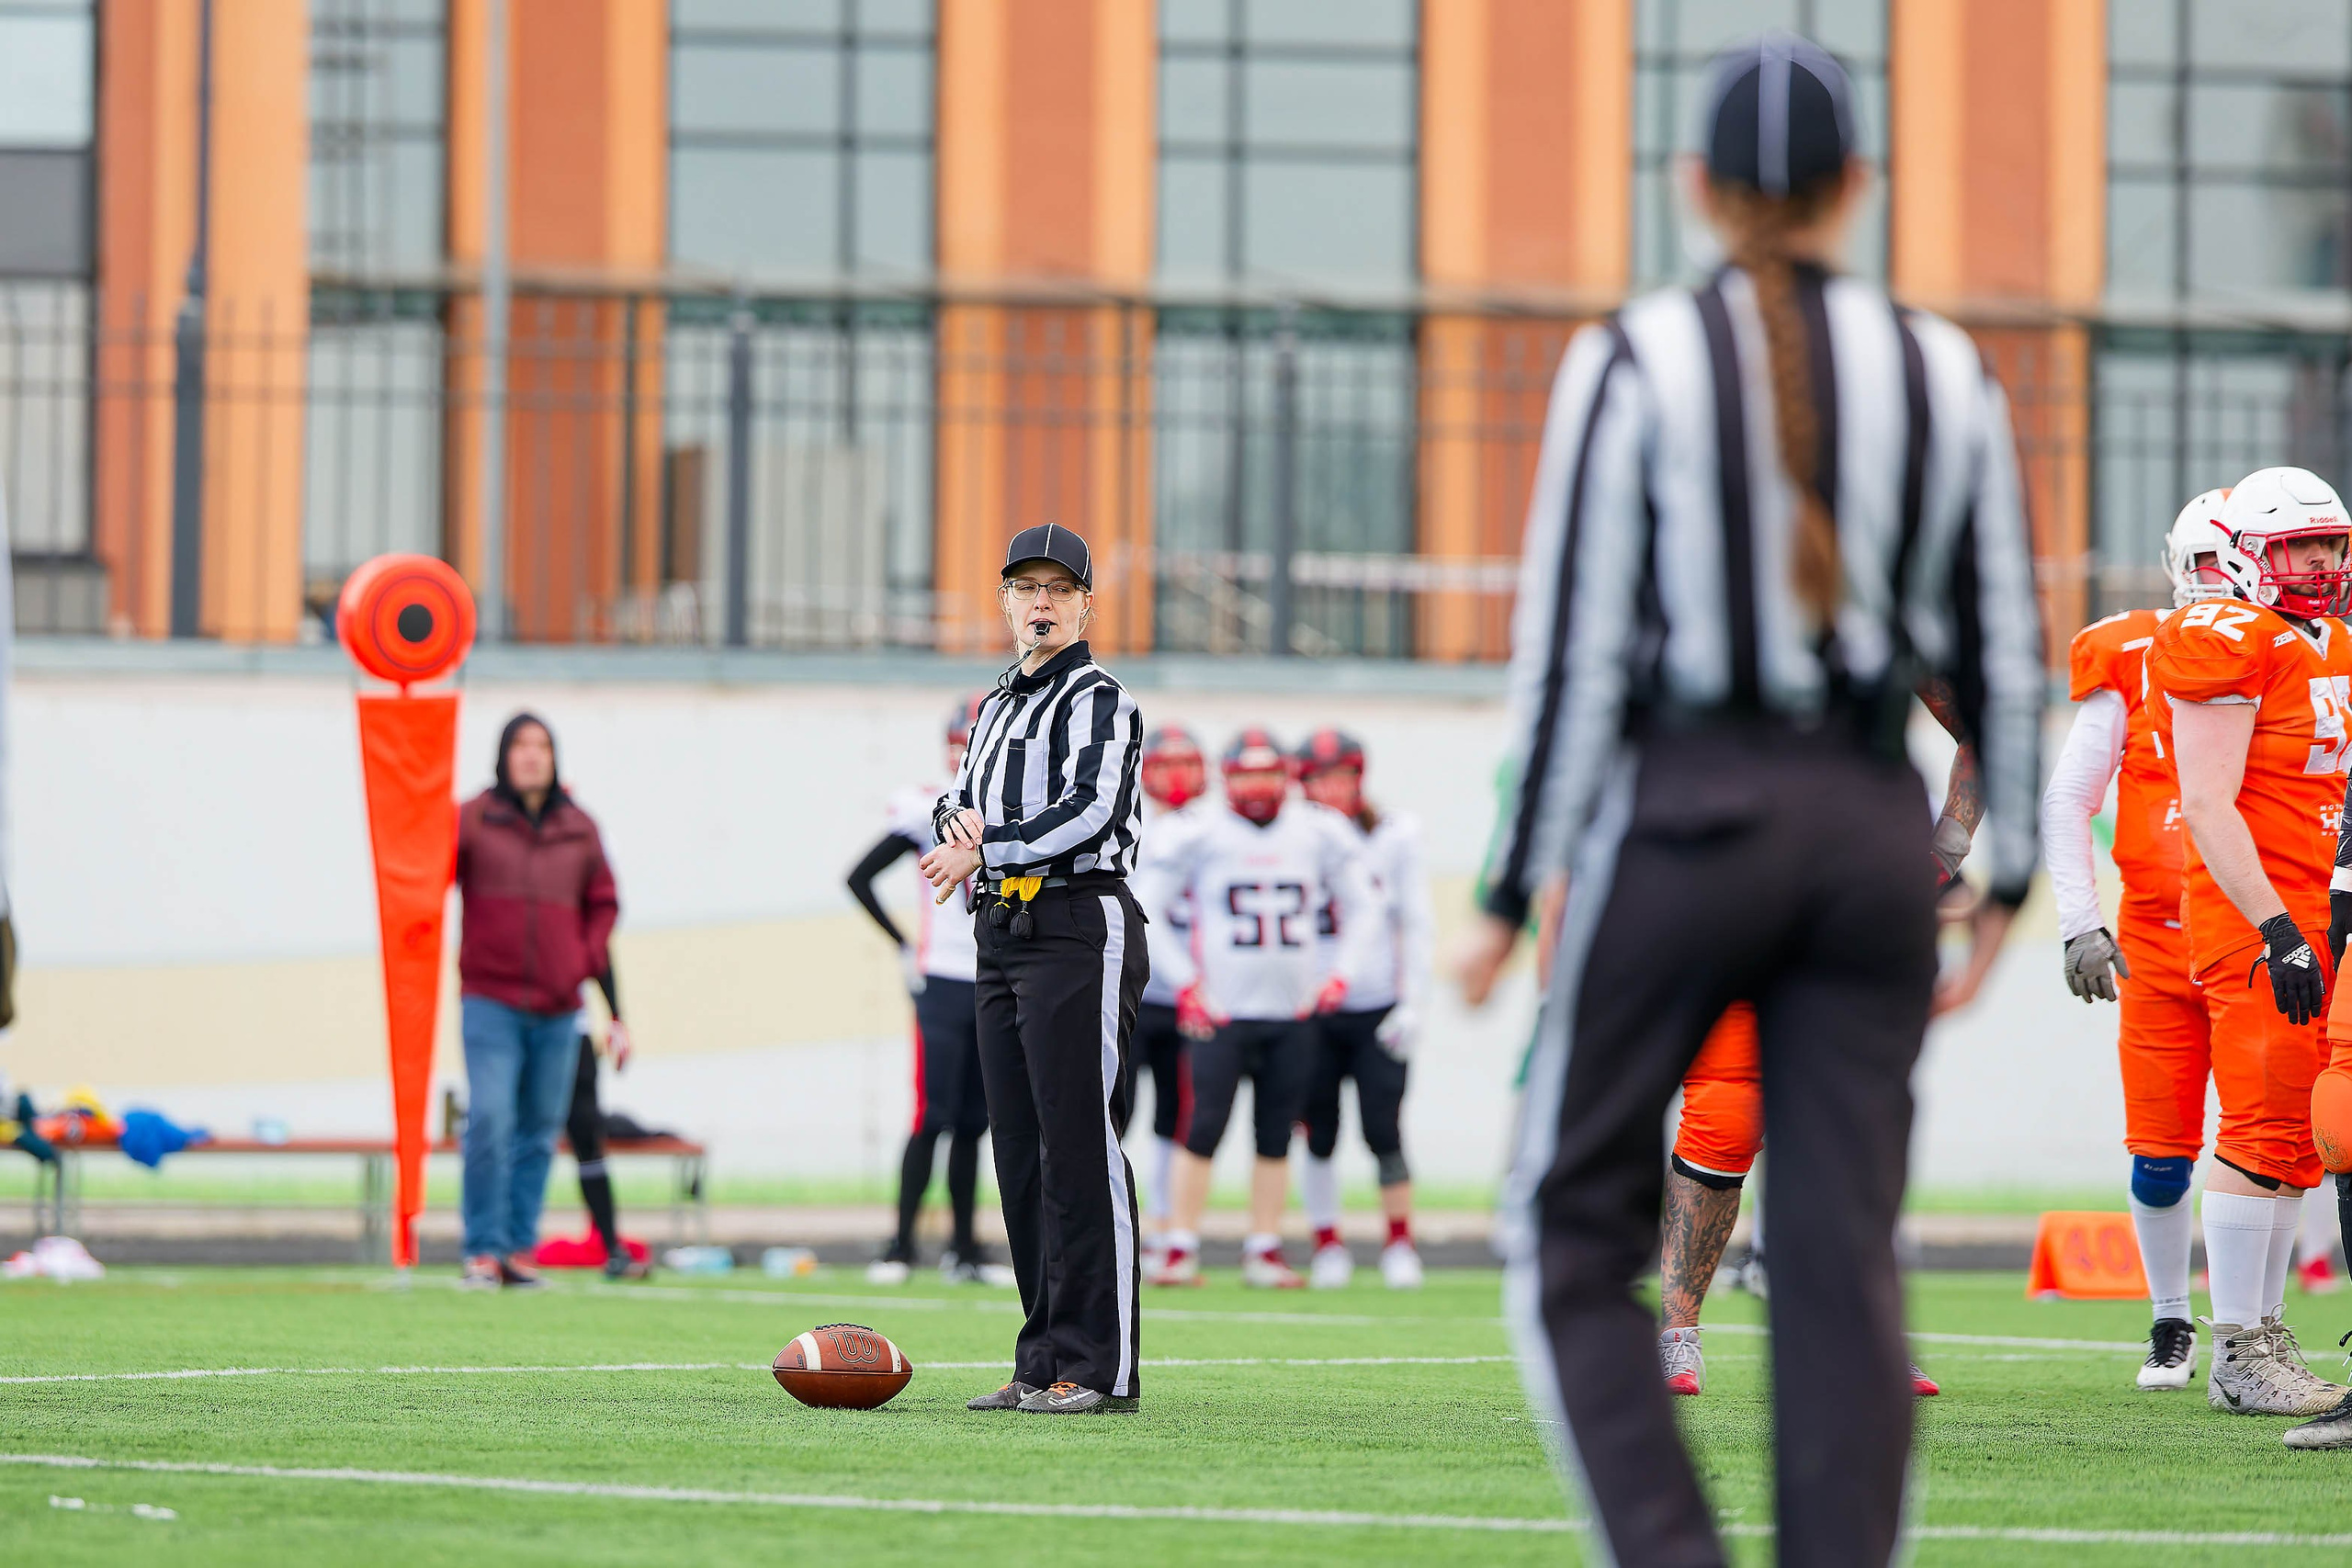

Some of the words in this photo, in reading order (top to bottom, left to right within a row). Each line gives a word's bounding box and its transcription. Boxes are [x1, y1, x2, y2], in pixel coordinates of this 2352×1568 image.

[2180, 604, 2260, 642] 92
[1227, 882, 1306, 947] 52
[2281, 943, 2311, 964] adidas
